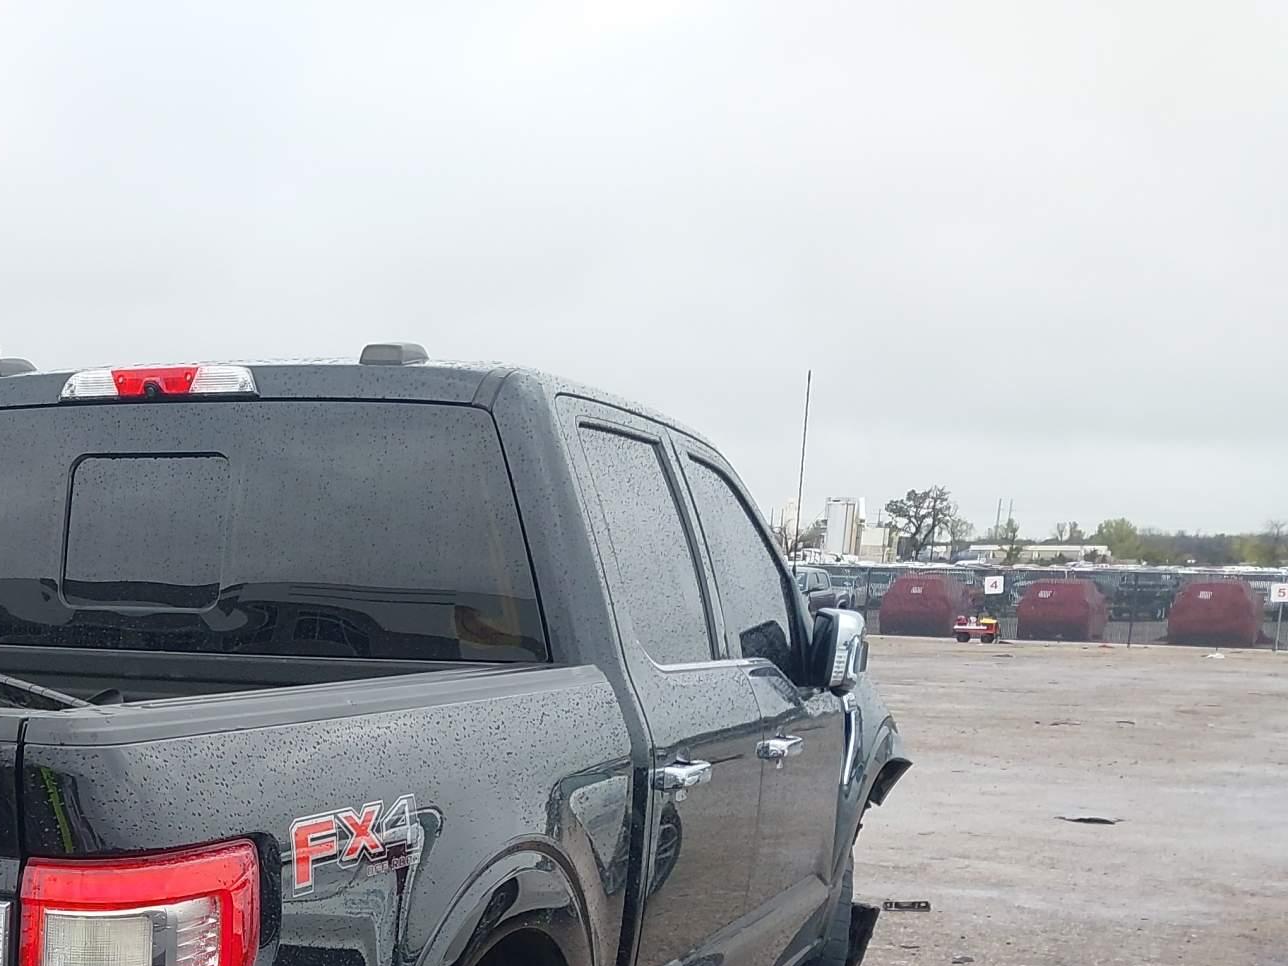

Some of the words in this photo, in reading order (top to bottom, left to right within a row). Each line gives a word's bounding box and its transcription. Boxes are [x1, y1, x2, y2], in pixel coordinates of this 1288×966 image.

[990, 580, 998, 589] 4
[1277, 587, 1286, 598] 5
[289, 793, 421, 898] FX4
